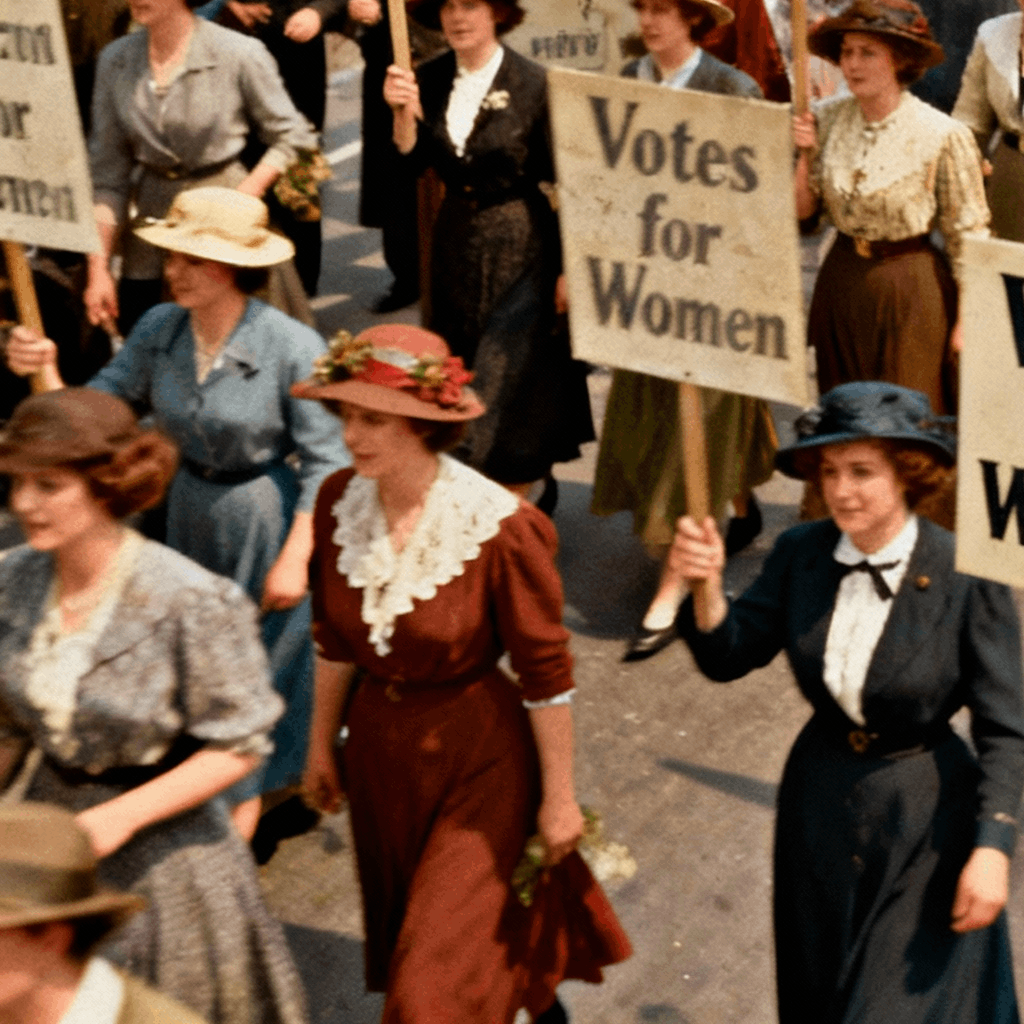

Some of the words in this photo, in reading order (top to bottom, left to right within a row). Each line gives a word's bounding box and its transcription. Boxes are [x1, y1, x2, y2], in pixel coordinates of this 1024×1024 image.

[588, 96, 758, 193] Votes
[638, 194, 722, 264] for
[587, 256, 788, 360] Women
